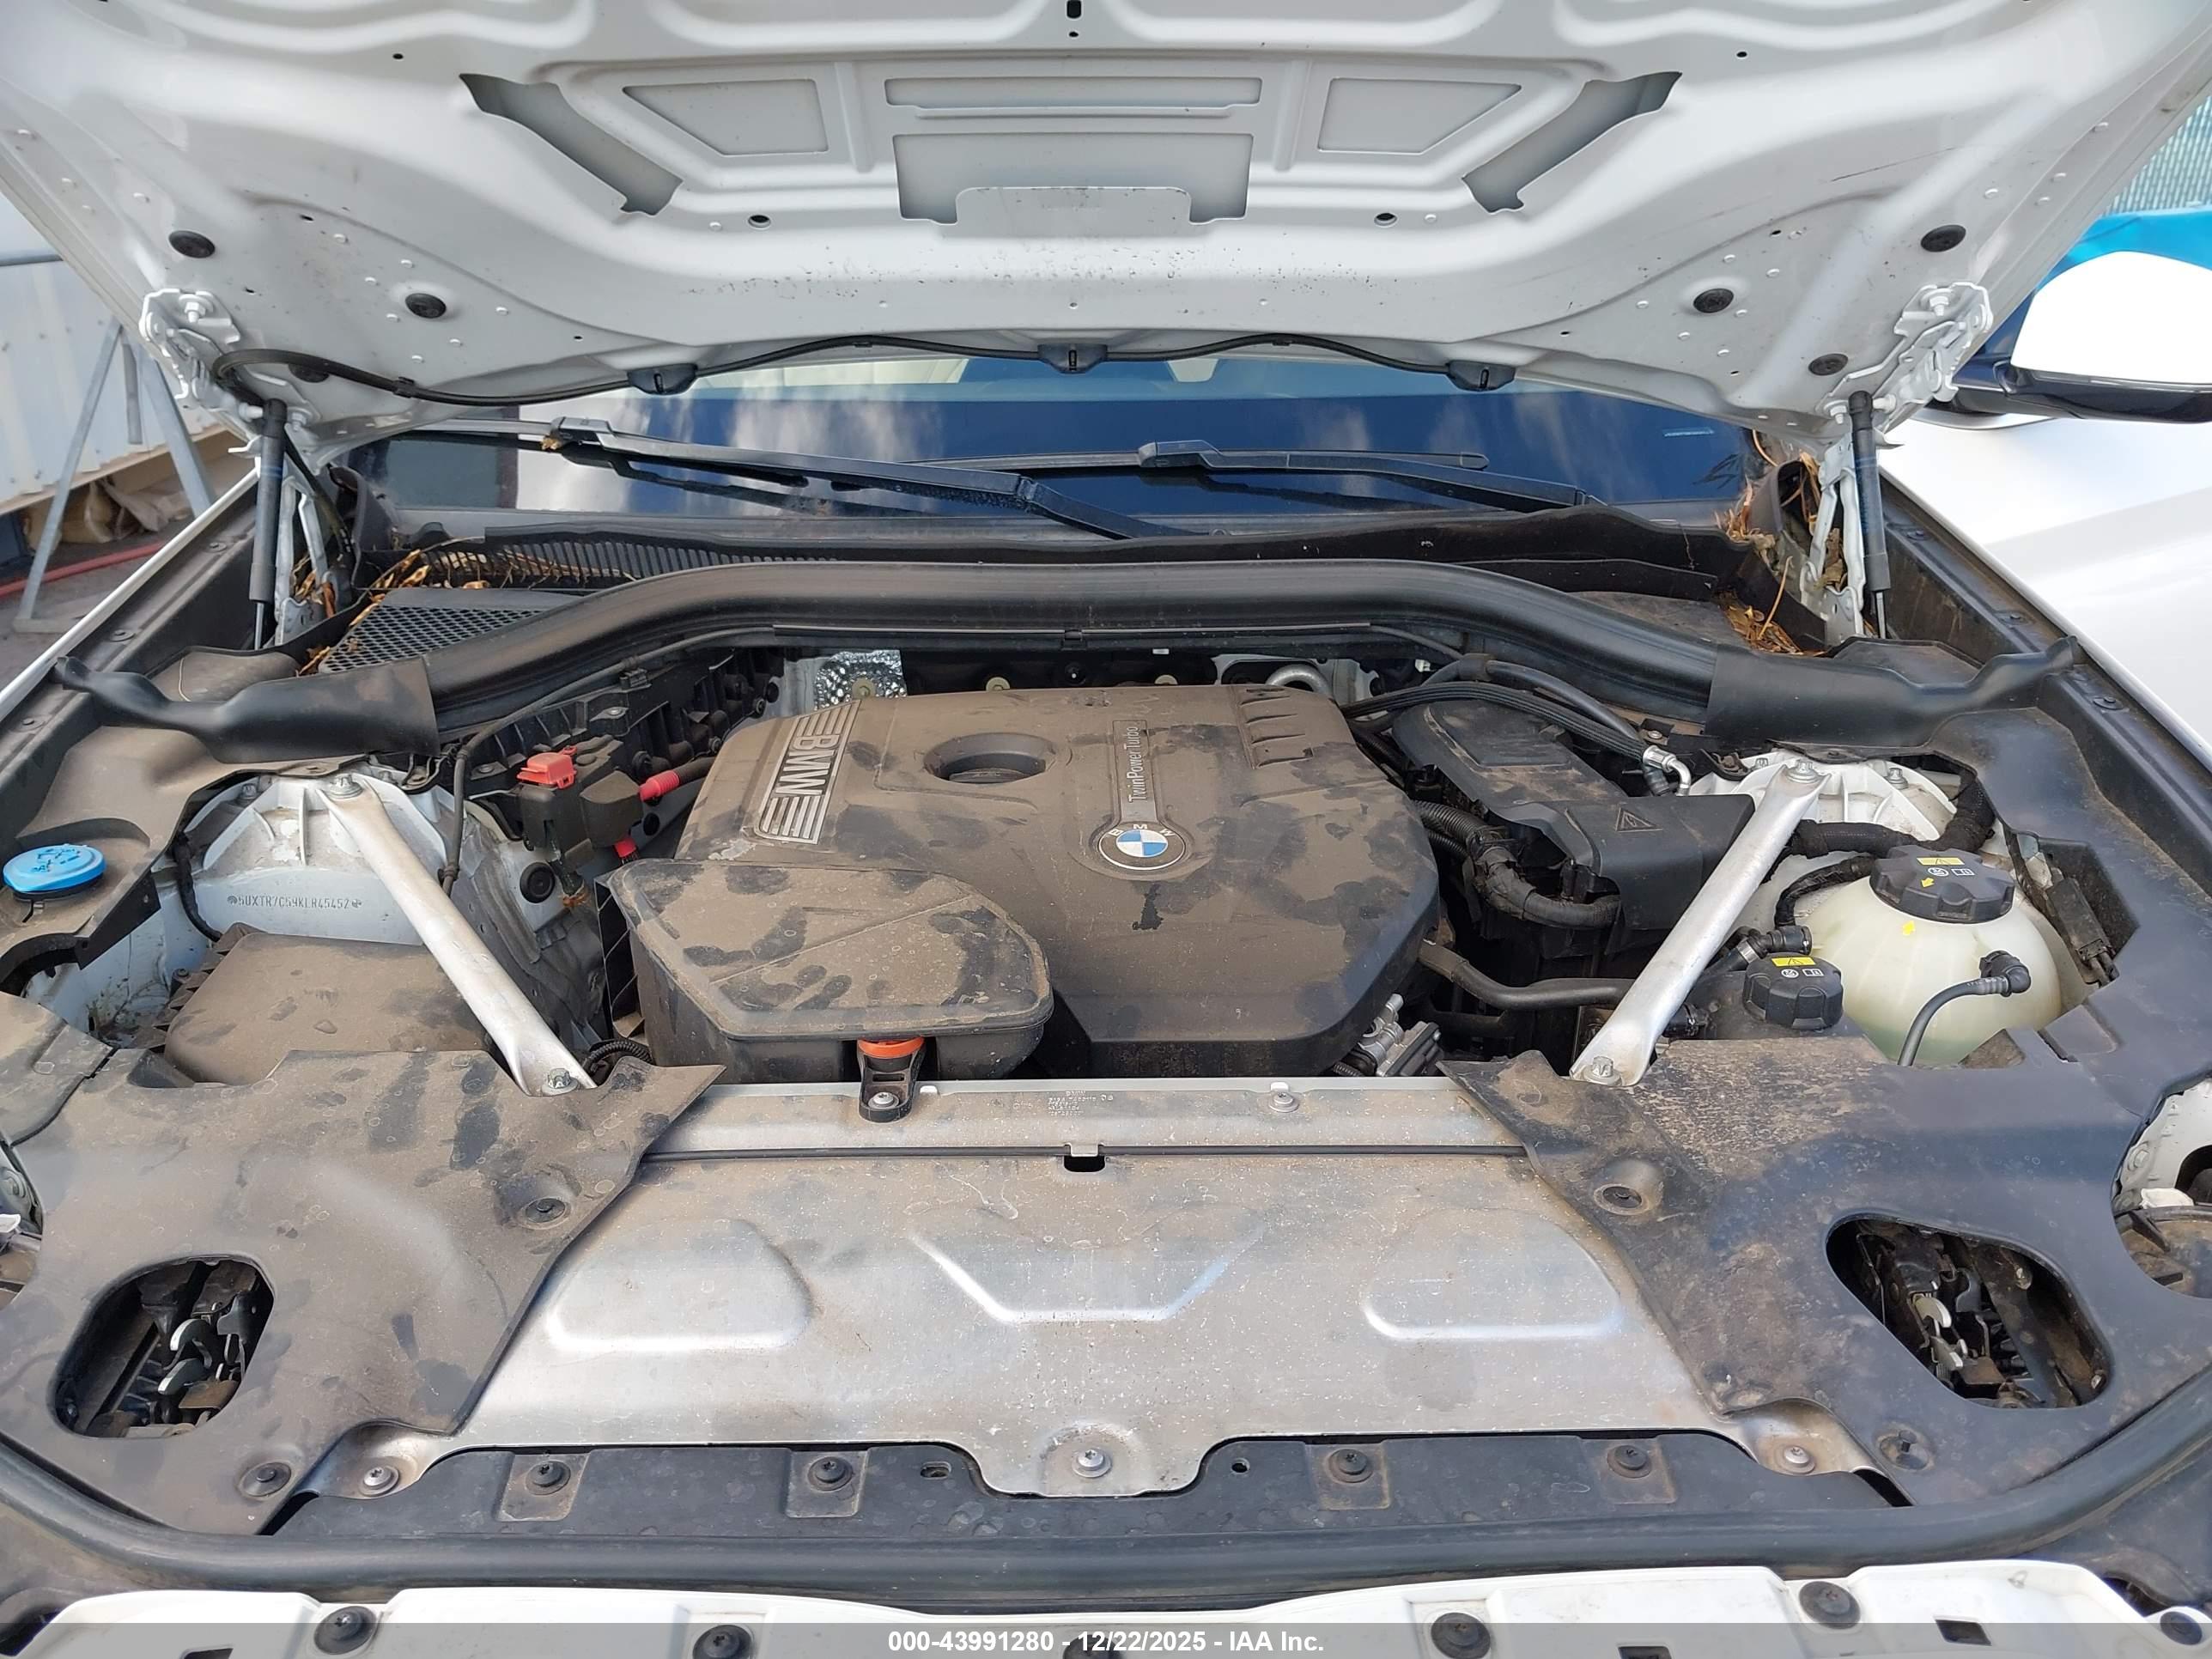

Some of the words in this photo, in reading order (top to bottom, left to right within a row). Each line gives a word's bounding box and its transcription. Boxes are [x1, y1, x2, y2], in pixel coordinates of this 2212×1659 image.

[1124, 726, 1141, 750] Turbo
[775, 734, 840, 795] BMW
[1127, 750, 1147, 802] TwinPower
[1109, 823, 1176, 837] BMW
